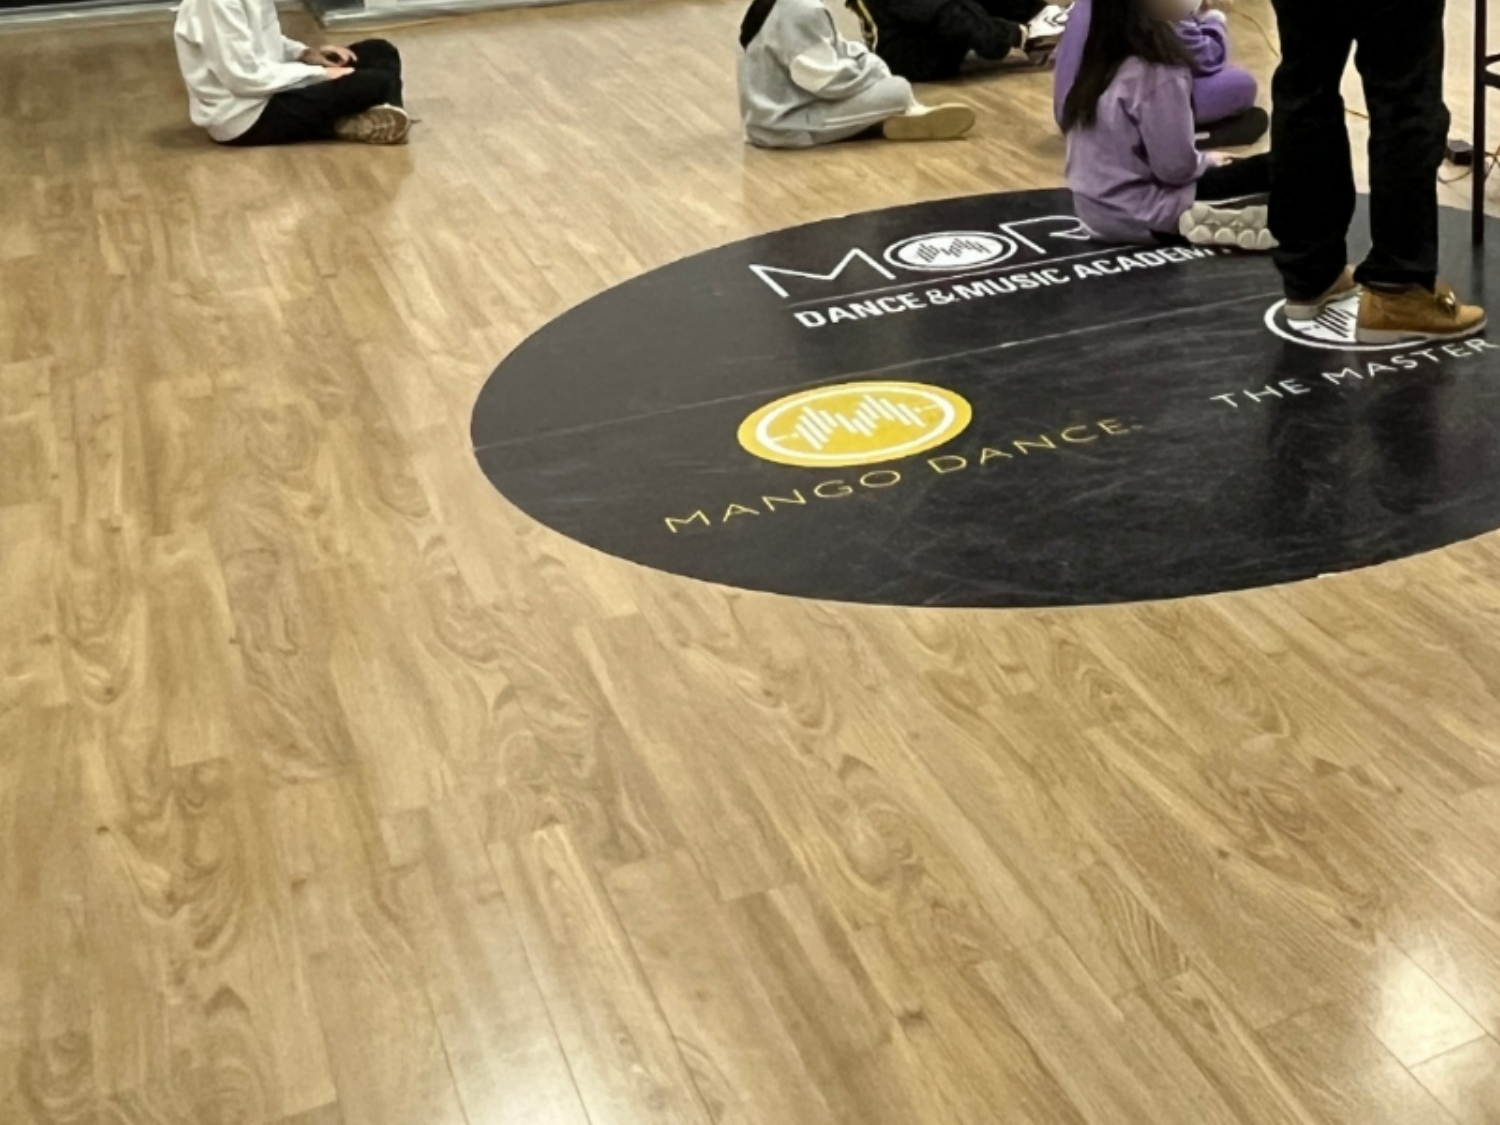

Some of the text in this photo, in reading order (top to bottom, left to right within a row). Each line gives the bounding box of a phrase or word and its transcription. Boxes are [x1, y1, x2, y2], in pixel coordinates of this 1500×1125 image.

[1074, 246, 1232, 279] ACADEM
[1210, 377, 1312, 409] THE
[1321, 337, 1500, 386] MASTER
[664, 418, 1131, 534] MANGO DANCE
